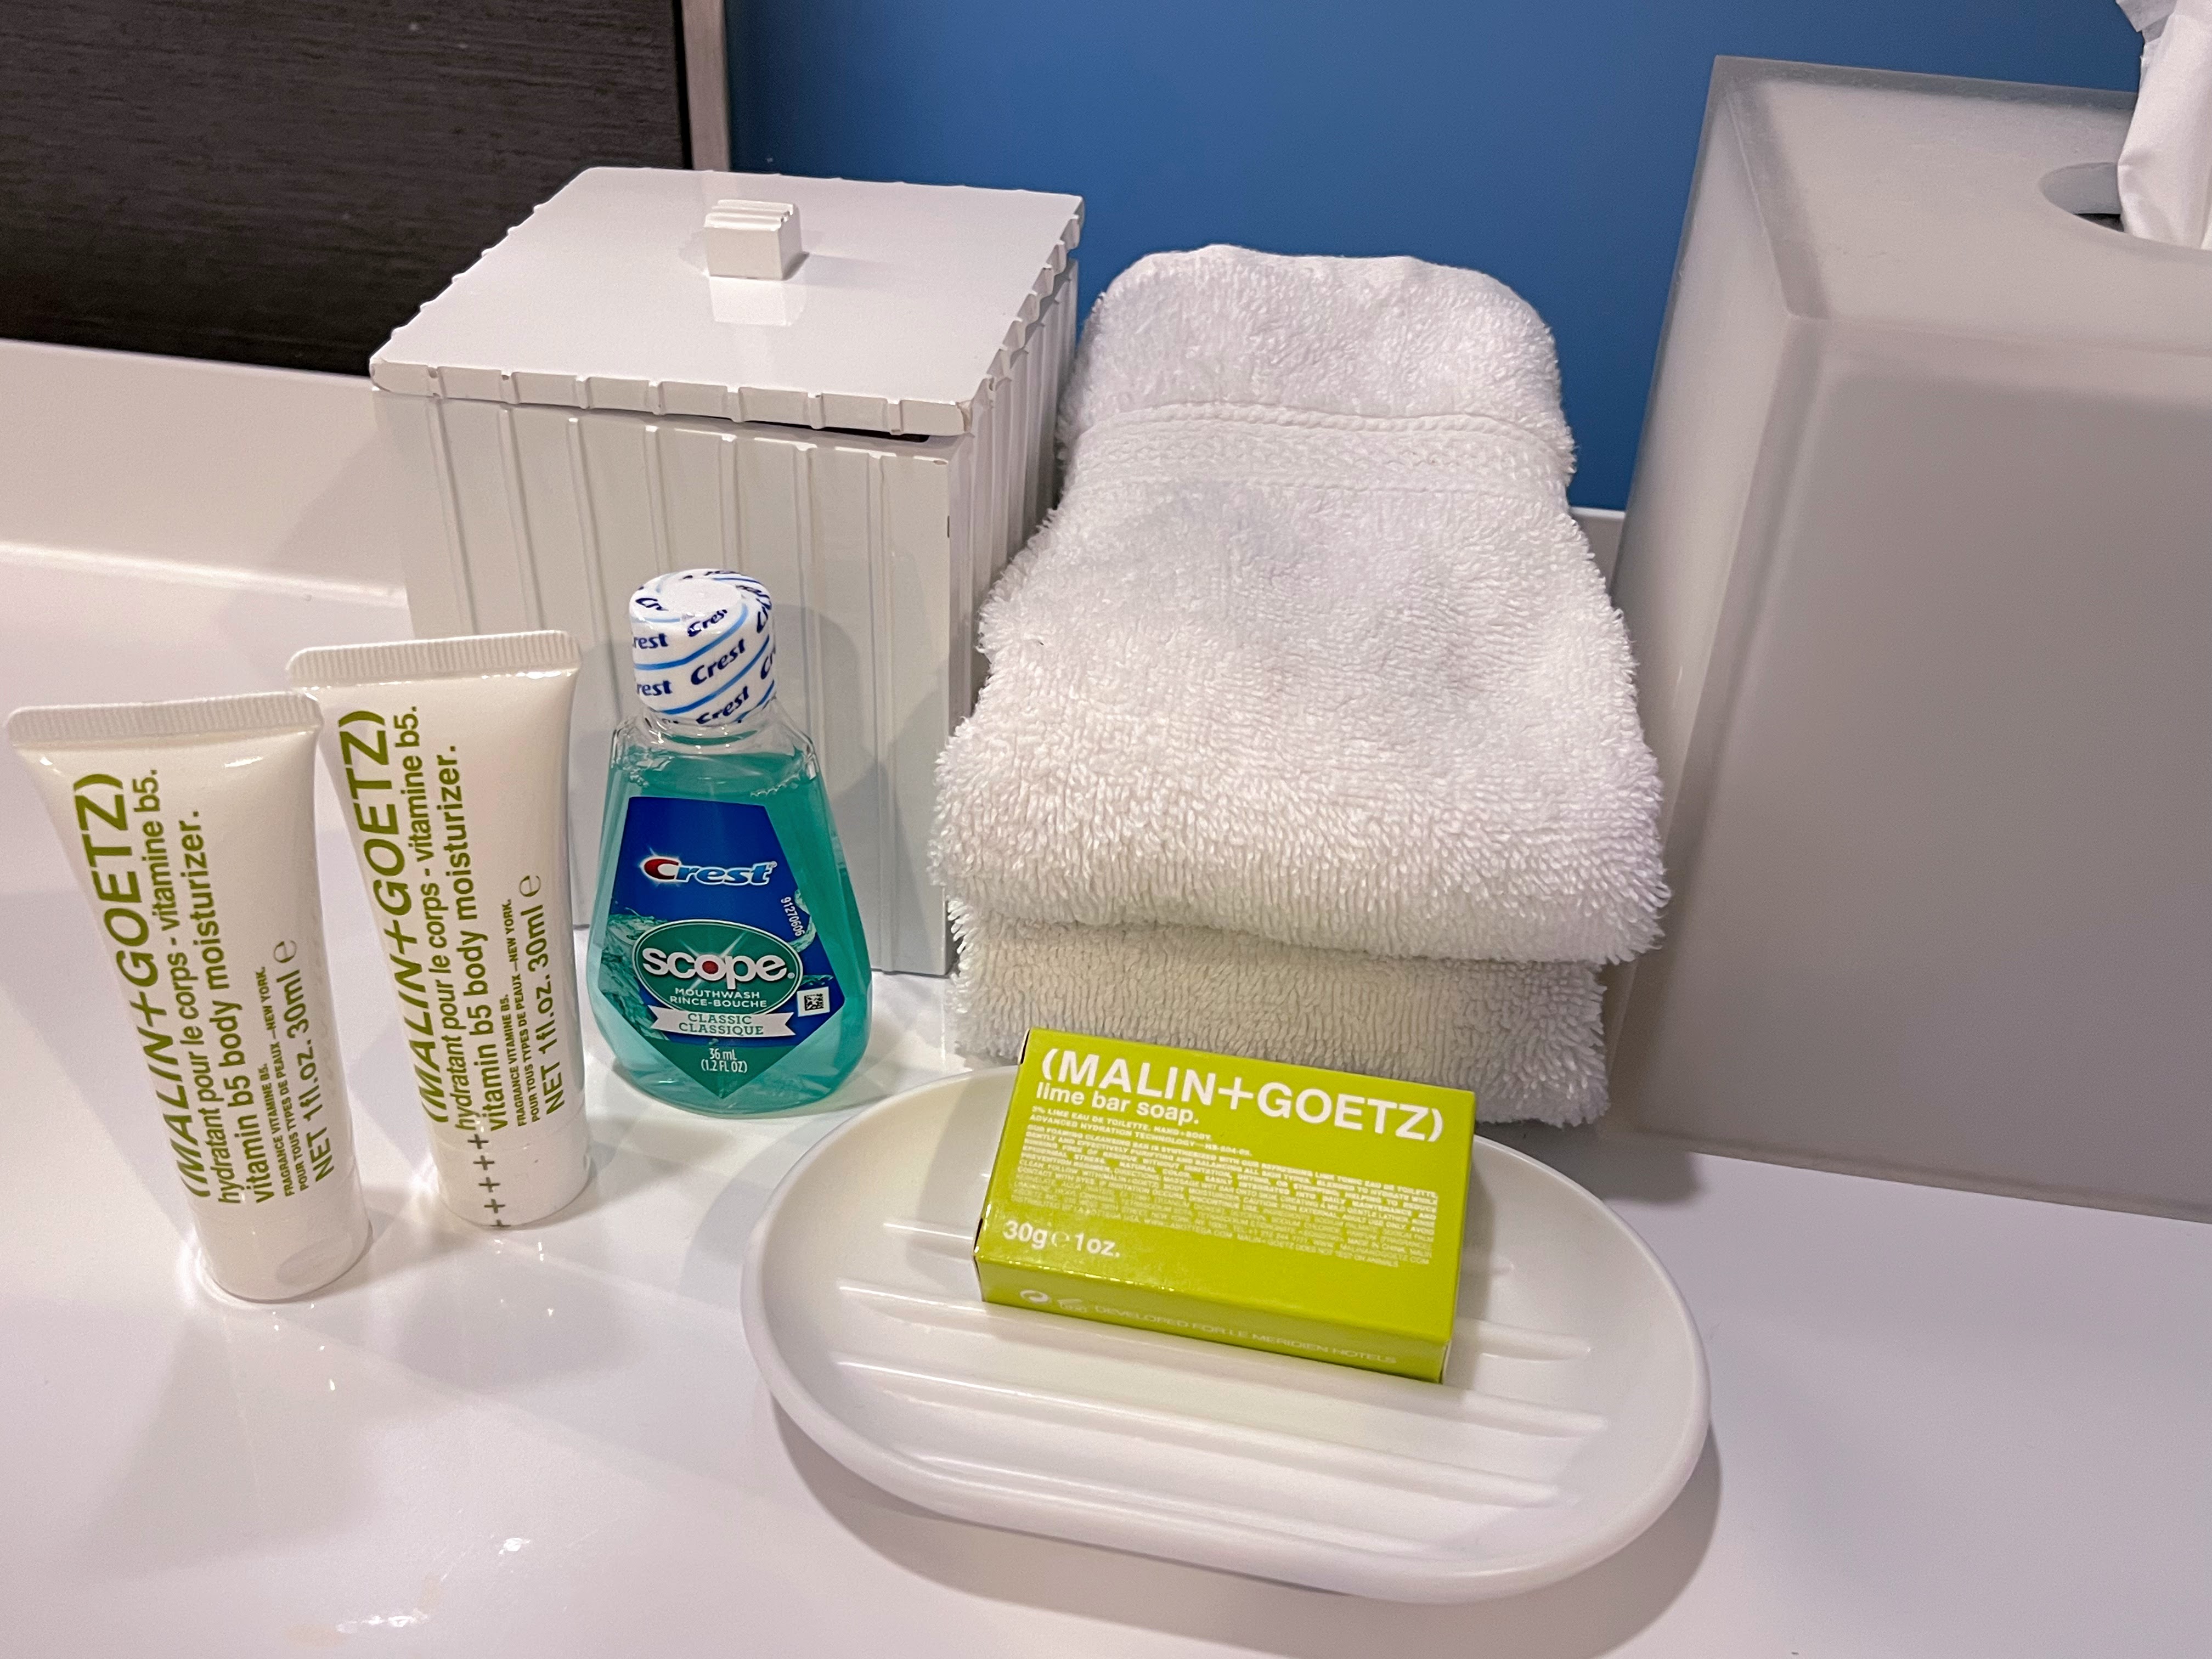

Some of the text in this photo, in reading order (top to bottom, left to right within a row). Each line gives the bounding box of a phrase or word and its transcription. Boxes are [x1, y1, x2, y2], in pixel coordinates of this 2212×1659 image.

[633, 633, 669, 649] rest
[691, 639, 746, 685] Crest
[636, 680, 749, 724] rest Crest
[393, 707, 420, 747] b5.
[132, 770, 160, 812] b5.
[400, 755, 434, 862] vitamine
[142, 821, 179, 931] vitamine
[641, 856, 772, 885] Crest
[338, 710, 448, 1122] (MALIN+GOETZ)
[420, 883, 448, 949] corps
[437, 746, 508, 1131] vitamin b5 body moisturizer.
[520, 905, 549, 972] 30ml
[74, 774, 209, 1197] (MALIN+GOETZ)
[167, 952, 199, 1020] corps
[428, 955, 451, 974] le
[179, 811, 274, 1203] vitamin b5 body moisturizer.
[276, 970, 308, 1039] 30ml
[436, 979, 466, 1030] pour
[512, 974, 524, 1011] PEAUX
[670, 996, 767, 1008] RINCE-BOUCHE
[675, 988, 760, 999] MOUTHWASH
[180, 1026, 204, 1045] le
[502, 1014, 517, 1064] VITAMINE
[517, 1013, 527, 1028] DE
[679, 1023, 764, 1036] CLASSIQUE
[688, 1013, 752, 1024] CLASSIC
[270, 1042, 285, 1079] PEAUX
[519, 1029, 531, 1063] TYPES
[709, 1048, 737, 1060] 36 mL
[719, 1060, 729, 1071] FL
[731, 1060, 748, 1073] OZ)
[188, 1051, 224, 1102] pour
[278, 1080, 289, 1096] DE
[441, 1035, 479, 1130] hydratant
[509, 1066, 527, 1126] FRAGRANCE
[524, 1064, 535, 1092] TOUS
[540, 1062, 564, 1114] NET
[1042, 1048, 1444, 1142] (MALIN+GOETZ)
[262, 1084, 280, 1134] VITAMINE
[281, 1097, 295, 1131] TYPES
[528, 1093, 540, 1122] POUR
[1036, 1082, 1199, 1126] lime bar soap.
[198, 1108, 245, 1203] hydratant
[273, 1136, 295, 1197] FRAGRANCE
[289, 1132, 301, 1160] TOUS
[307, 1128, 333, 1182] NET
[295, 1162, 307, 1190] POUR
[1003, 1220, 1048, 1250] 30g
[1094, 1305, 1189, 1328] DEVELOPED
[1193, 1323, 1227, 1335] FOR
